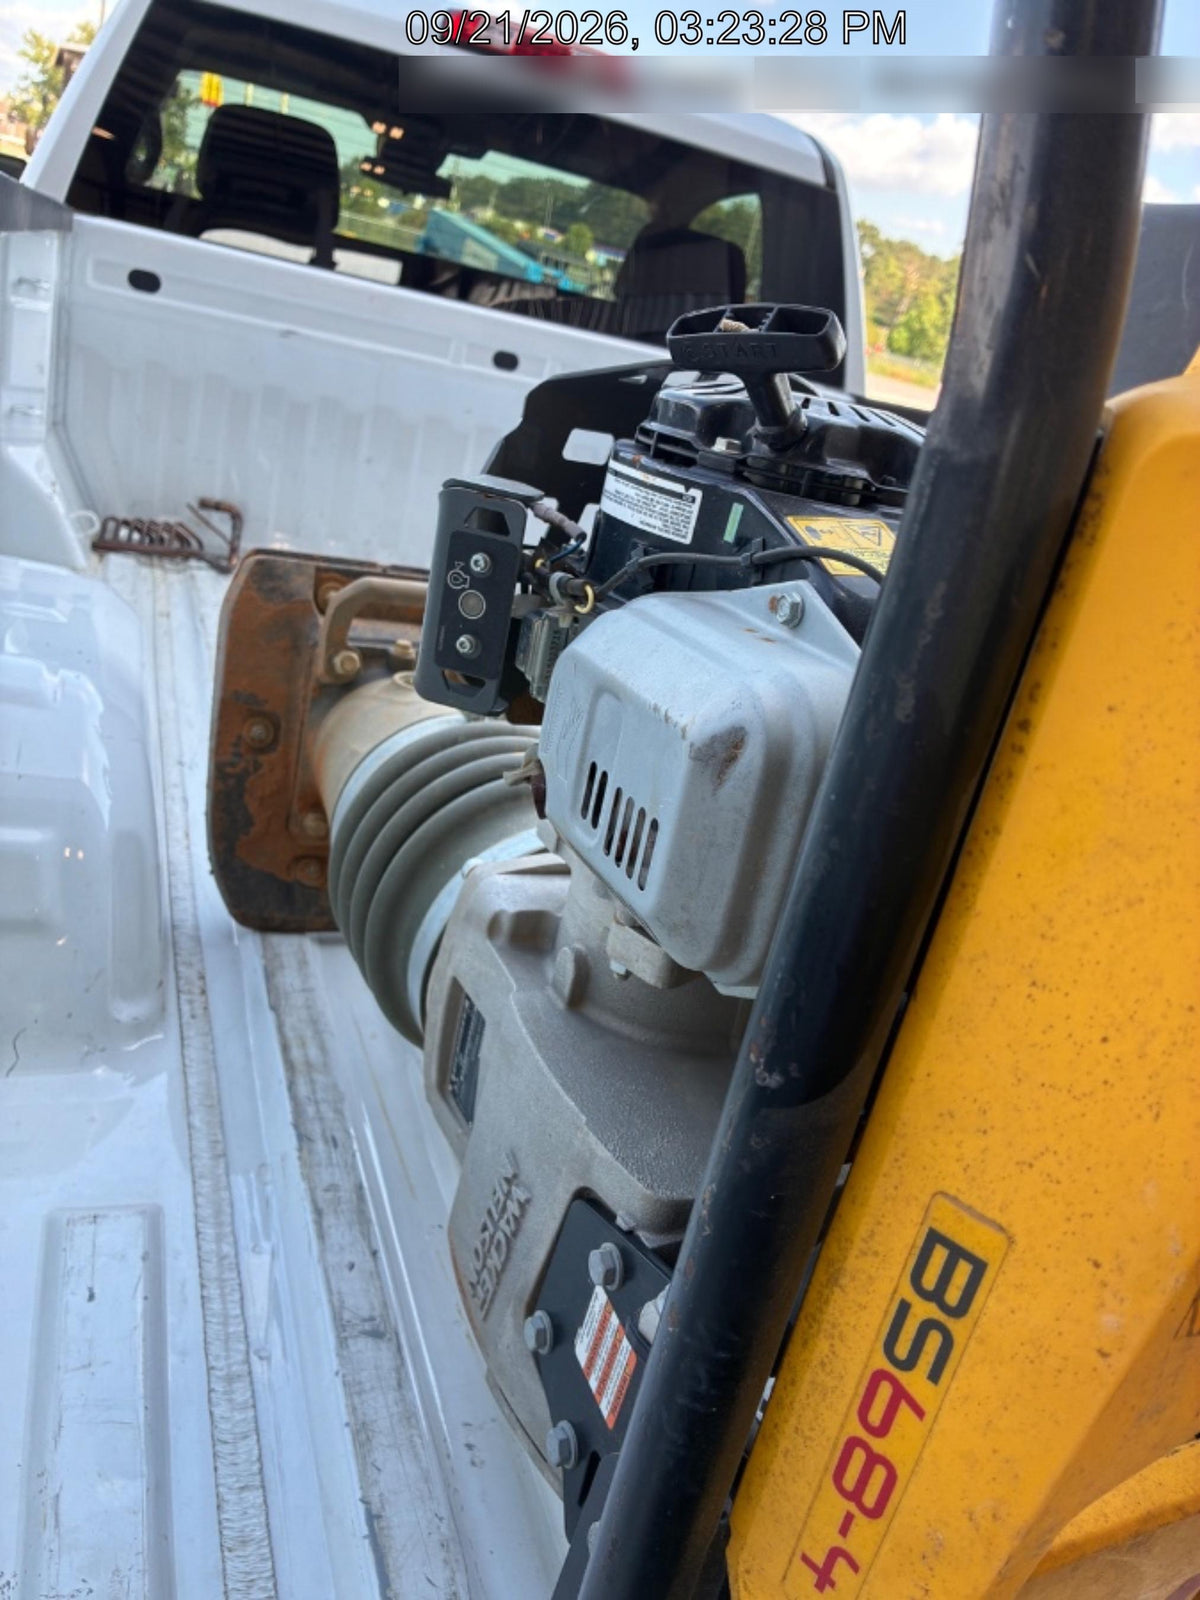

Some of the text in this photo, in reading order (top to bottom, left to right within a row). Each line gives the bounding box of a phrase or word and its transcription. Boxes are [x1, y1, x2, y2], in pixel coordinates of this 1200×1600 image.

[702, 342, 777, 360] START
[480, 1185, 532, 1322] WACKER
[801, 1226, 989, 1594] BS68-4
